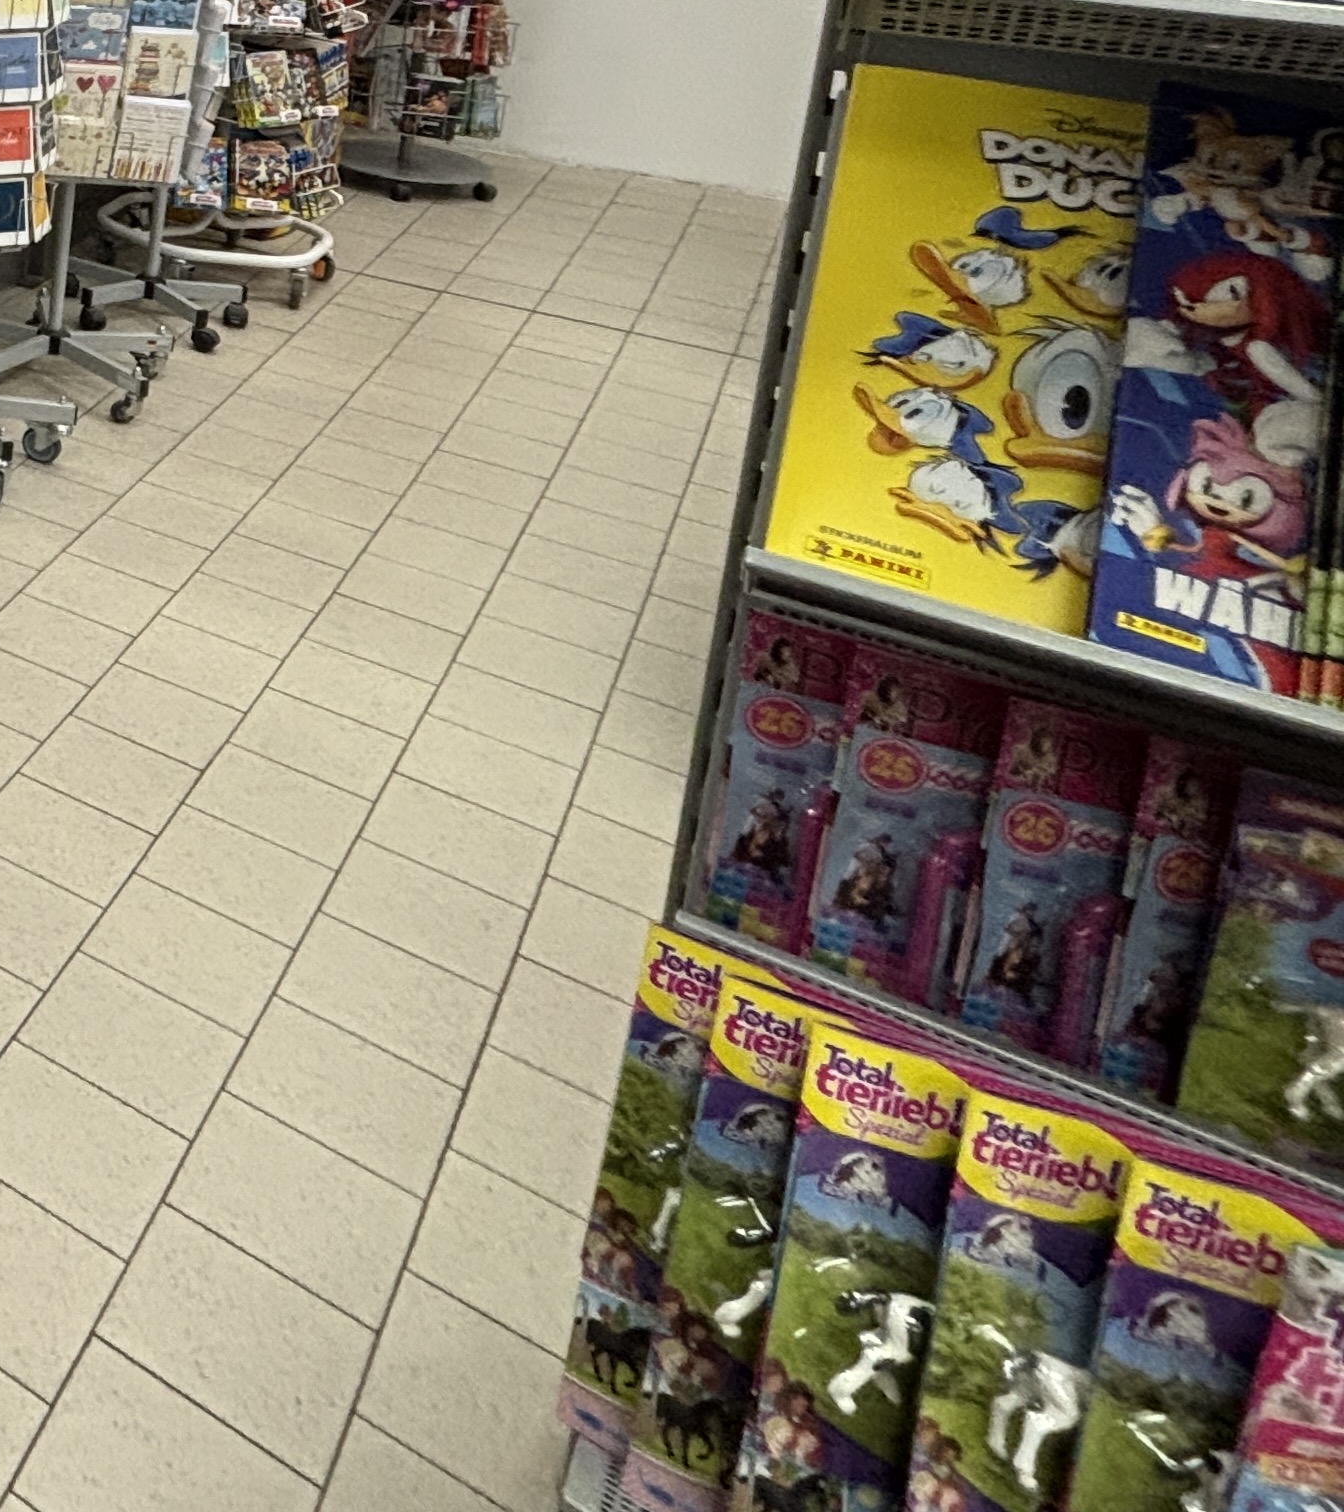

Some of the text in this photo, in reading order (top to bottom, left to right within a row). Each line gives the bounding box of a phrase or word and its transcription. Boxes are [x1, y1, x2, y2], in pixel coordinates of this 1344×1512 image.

[997, 162, 1141, 217] DUC
[840, 547, 925, 581] PANINI
[656, 940, 723, 989] Total
[732, 994, 807, 1045] Total
[823, 1042, 905, 1094] Total
[814, 1062, 966, 1139] tierlieb!
[981, 1110, 1060, 1155] Total
[971, 1131, 1124, 1201] tierlieb!
[1144, 1181, 1234, 1233] Total
